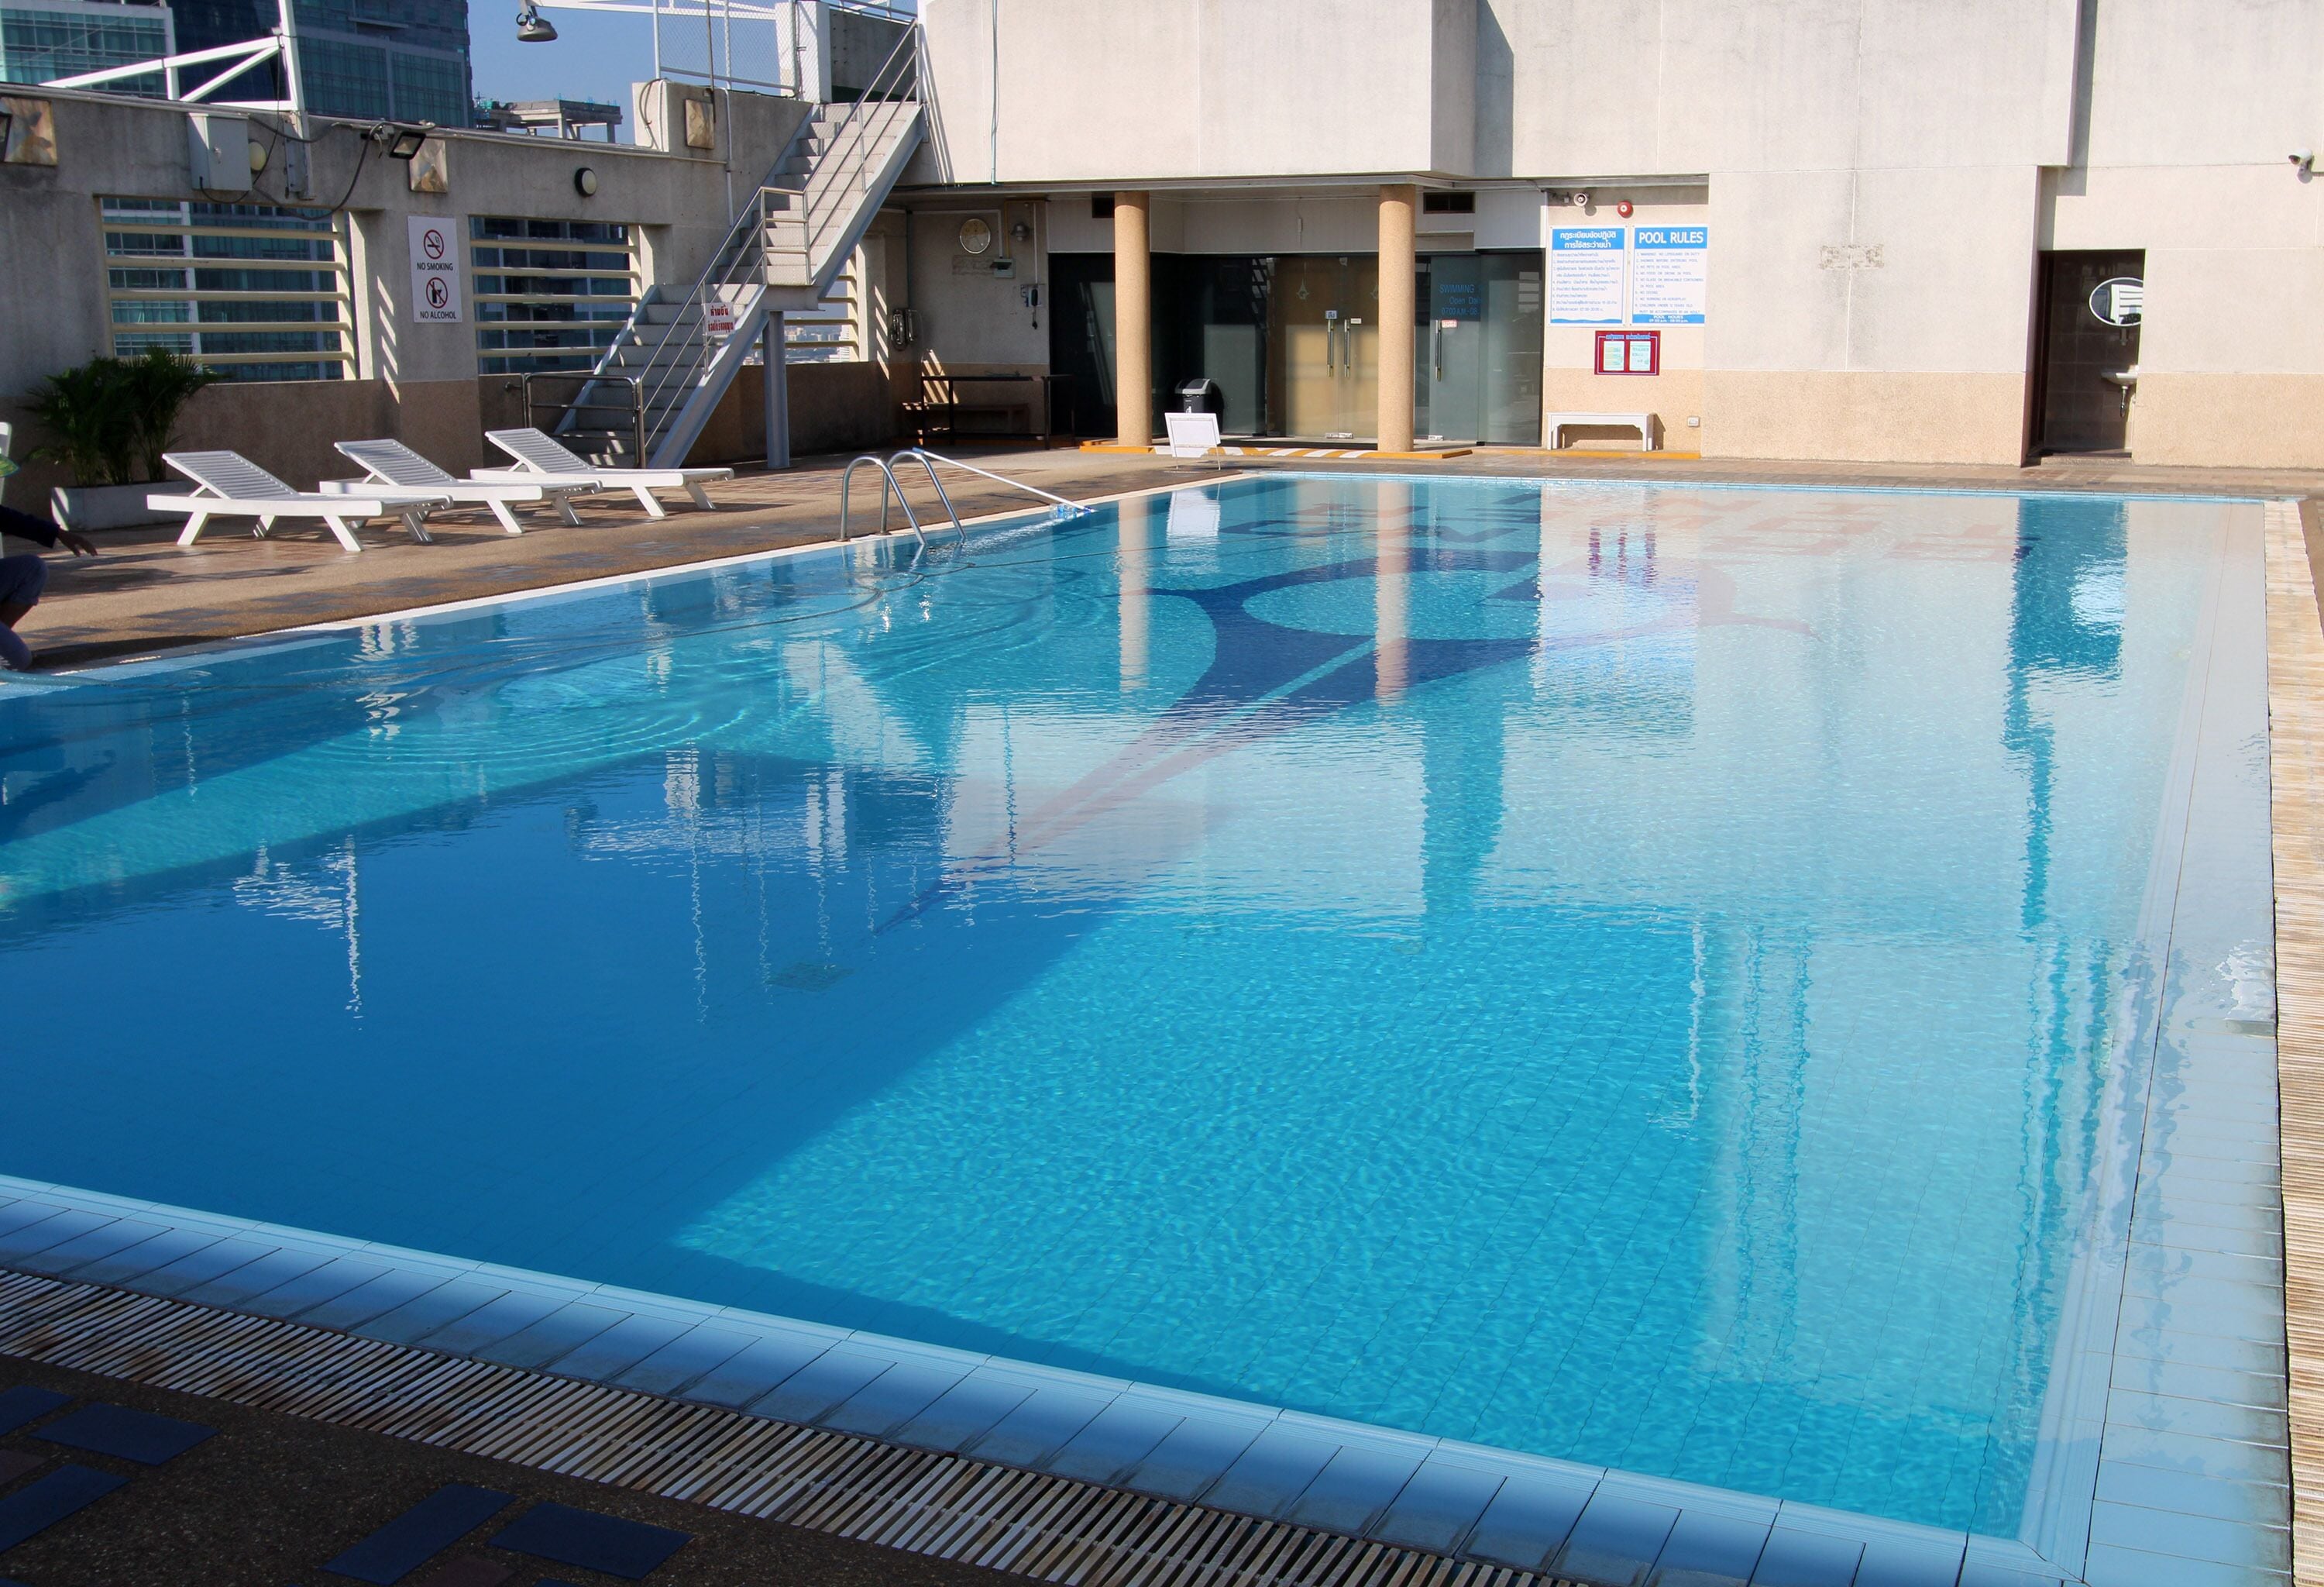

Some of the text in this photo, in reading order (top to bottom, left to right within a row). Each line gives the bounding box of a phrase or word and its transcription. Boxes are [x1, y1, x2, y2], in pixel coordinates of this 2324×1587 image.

[1639, 231, 1703, 244] POOL RULES
[1564, 240, 1611, 248] การใช้สระว่ายน้ำ
[427, 263, 453, 271] SMOKING
[1439, 284, 1475, 293] SWIMMING
[420, 311, 456, 319] NO ALCOHOL
